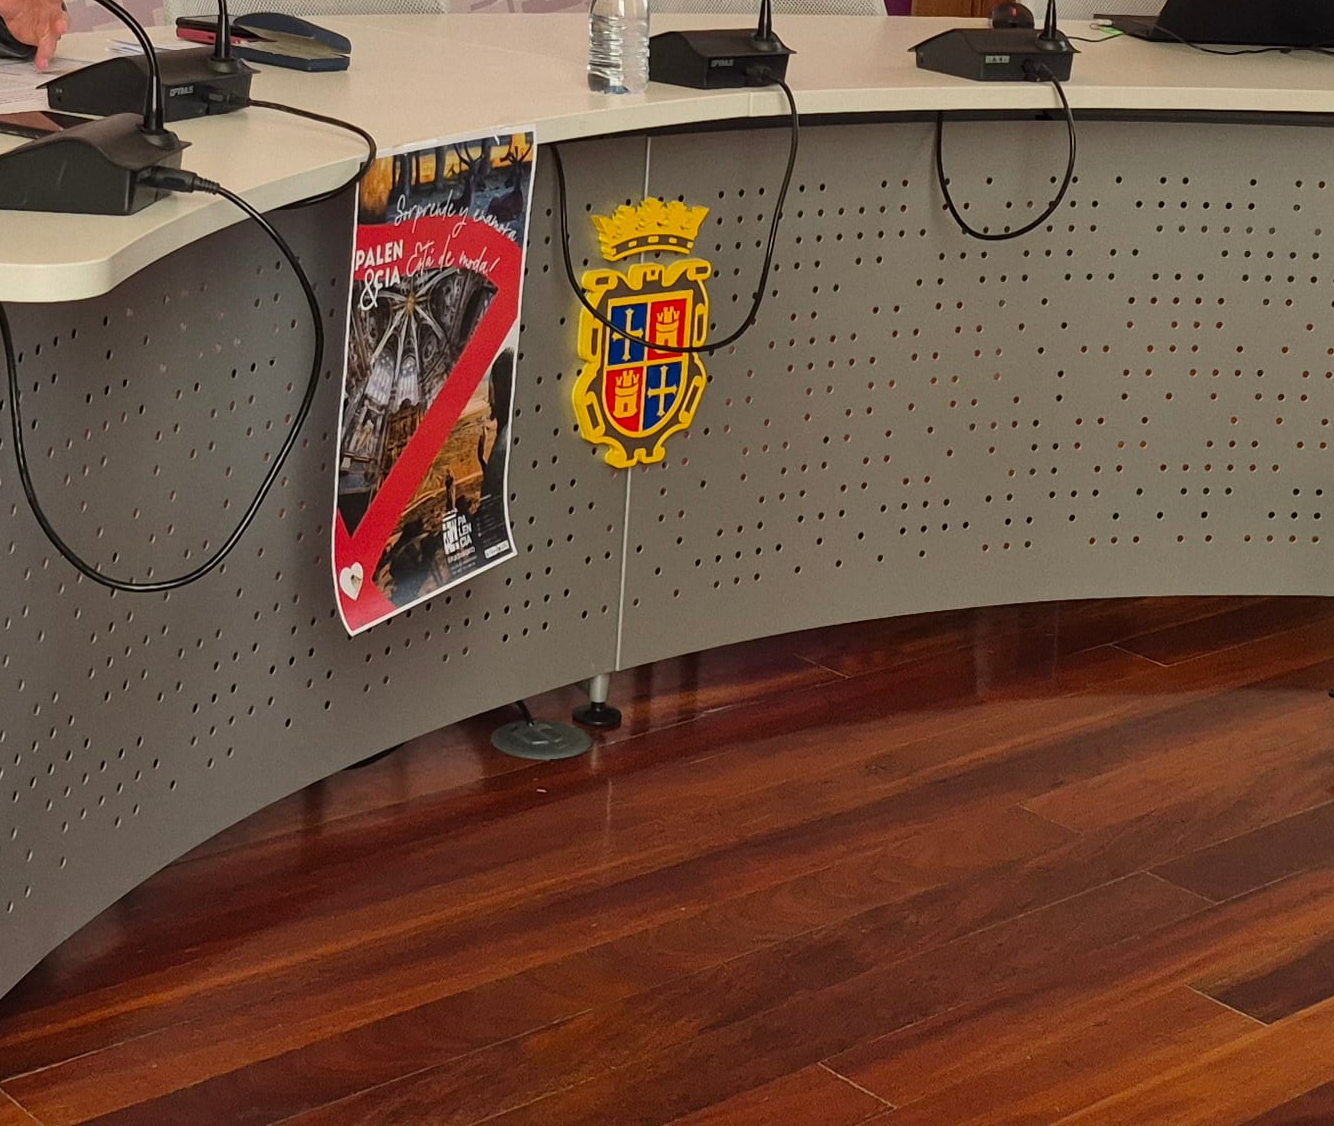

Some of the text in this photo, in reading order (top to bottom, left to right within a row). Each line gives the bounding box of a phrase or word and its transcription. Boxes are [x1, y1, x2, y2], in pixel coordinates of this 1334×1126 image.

[395, 189, 456, 233] Sorprende
[452, 206, 468, 238] y
[355, 239, 403, 271] PALEN
[438, 234, 455, 272] de
